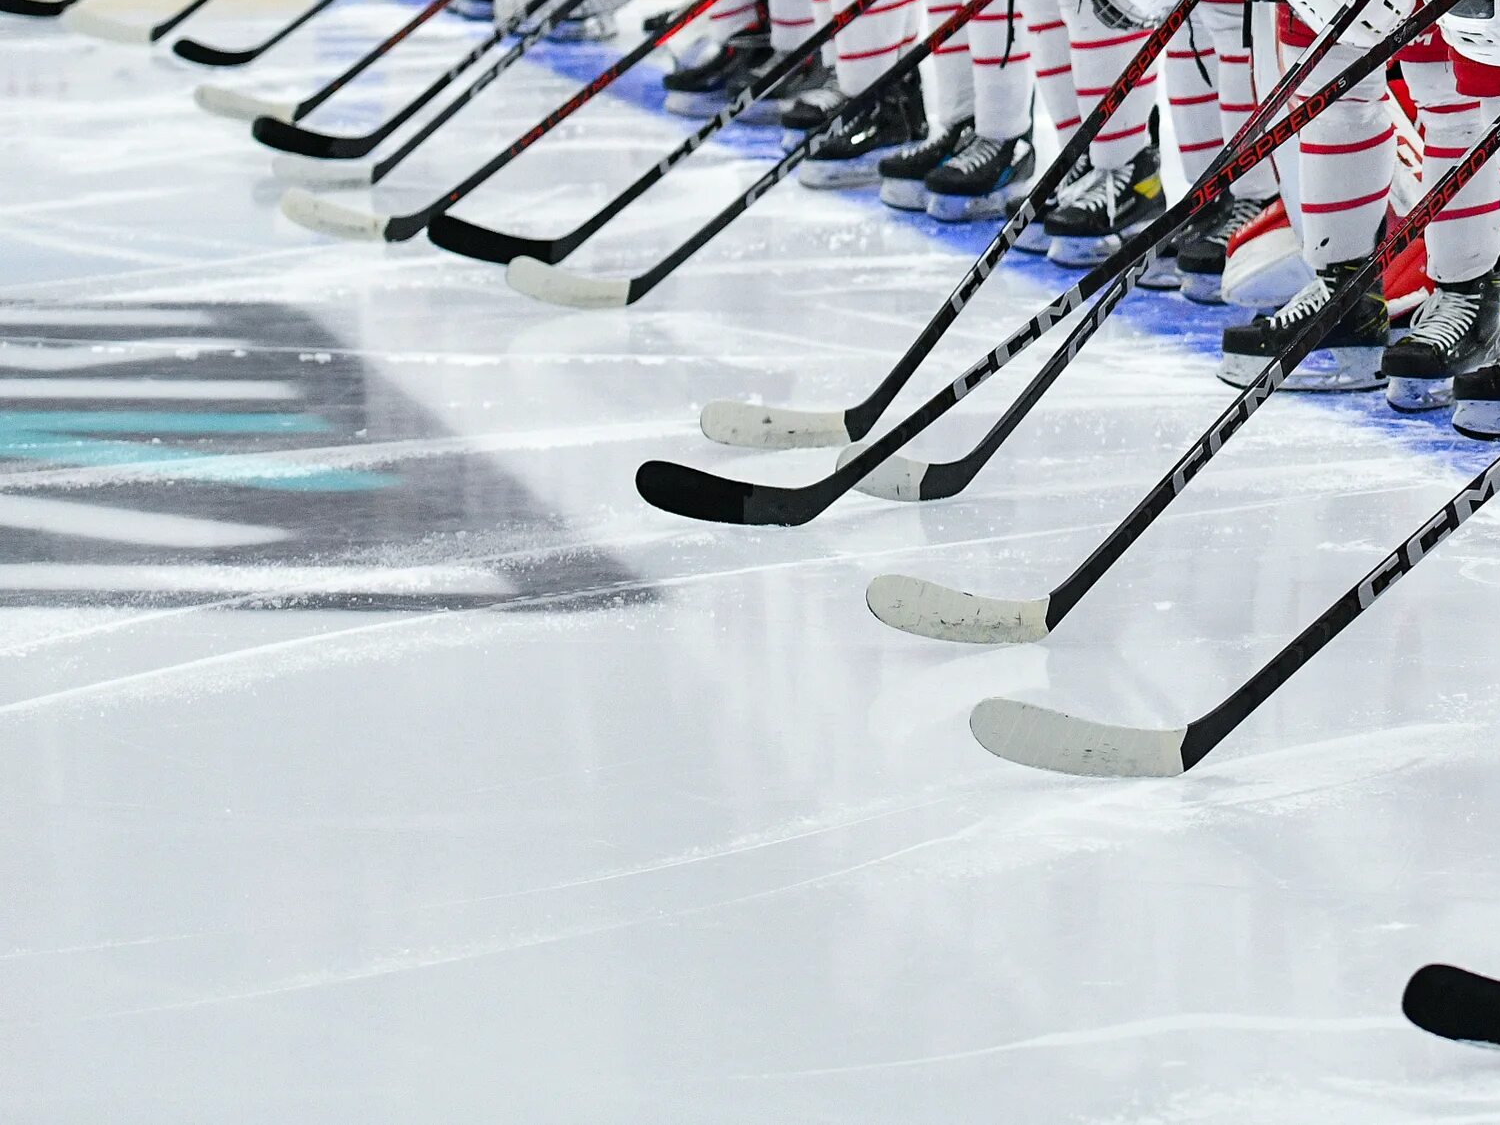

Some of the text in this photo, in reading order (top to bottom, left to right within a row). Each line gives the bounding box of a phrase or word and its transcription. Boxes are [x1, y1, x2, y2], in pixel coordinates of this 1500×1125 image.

[1099, 10, 1183, 126] JETSPEED
[1189, 93, 1327, 215] JETSPEED
[1375, 148, 1487, 272] JETSPEED
[951, 198, 1036, 316] CCM
[953, 283, 1084, 401] CCM
[1172, 359, 1285, 497] CCM
